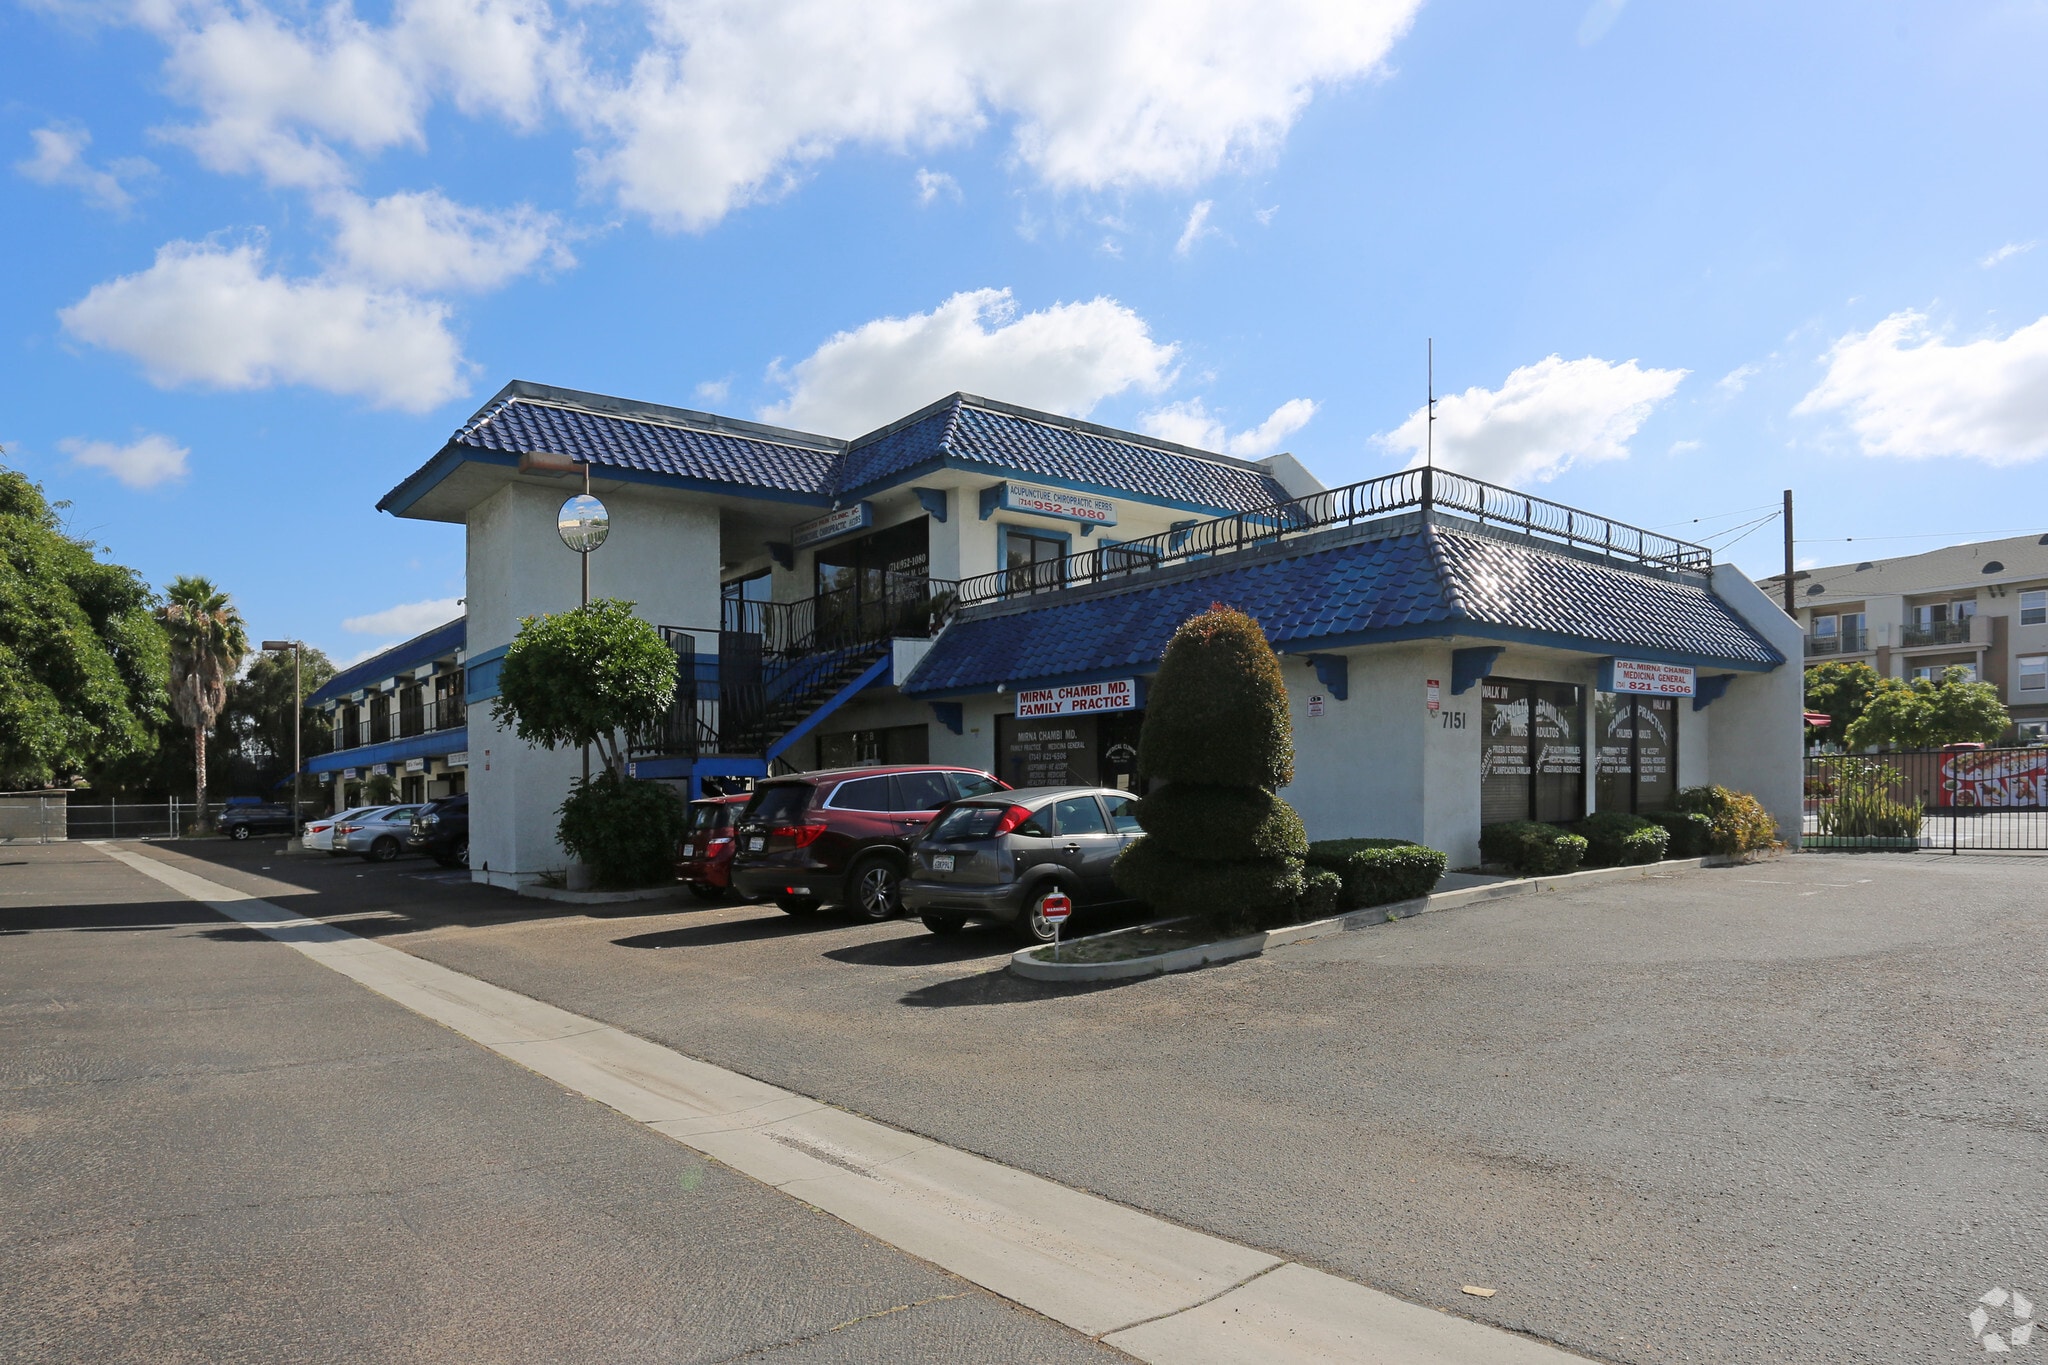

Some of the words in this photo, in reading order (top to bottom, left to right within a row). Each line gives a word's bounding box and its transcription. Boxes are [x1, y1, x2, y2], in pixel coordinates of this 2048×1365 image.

[1034, 500, 1105, 520] 952-1080
[1095, 500, 1112, 511] HERBS
[1617, 661, 1636, 670] DRA.
[1637, 663, 1661, 672] MIRNA
[1664, 666, 1692, 674] CHAMBI
[1624, 670, 1655, 680] MEDICINA
[1658, 674, 1686, 684] GENERAL
[1020, 690, 1053, 703] MIRNA
[1058, 684, 1102, 698] CHAMBI
[1108, 682, 1130, 694] MD.
[1482, 684, 1500, 698] WALK
[1501, 686, 1508, 699] IN
[1628, 682, 1692, 694] 821-6506
[1020, 702, 1062, 716] FAMILY
[1072, 695, 1130, 711] PRACTICE
[1441, 711, 1466, 729] 7151
[1492, 698, 1530, 736] CONSULTA
[1538, 698, 1570, 739] FAMILIAR
[1608, 704, 1632, 738] FAMILY
[1638, 704, 1668, 746] PRACTICE
[1018, 732, 1037, 742] MIRNA
[1038, 730, 1062, 740] CHAMBI
[1536, 726, 1560, 738] ADULTOS
